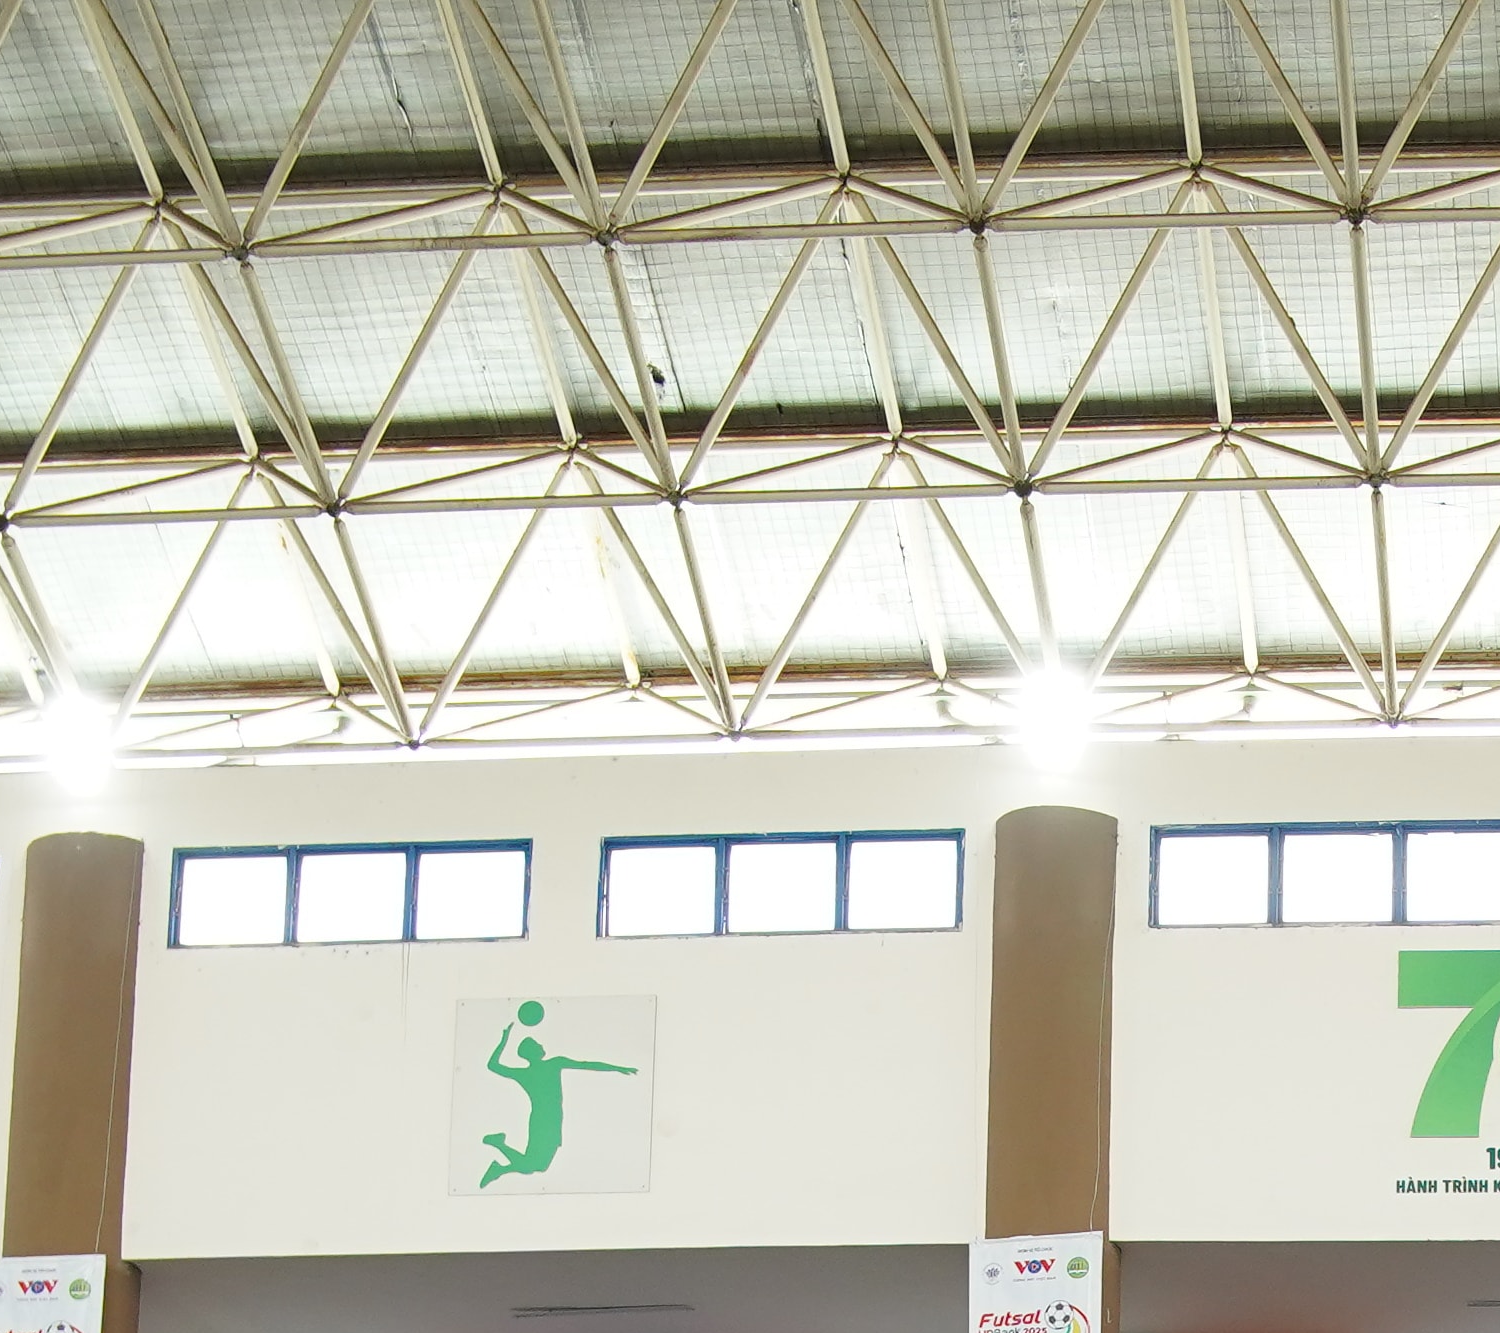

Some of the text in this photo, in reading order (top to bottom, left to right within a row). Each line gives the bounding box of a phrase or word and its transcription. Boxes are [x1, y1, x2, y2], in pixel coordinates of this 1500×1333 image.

[1396, 1177, 1438, 1194] HÀNH
[1443, 1177, 1489, 1194] TRÌNH
[979, 1309, 1041, 1328] Futsal
